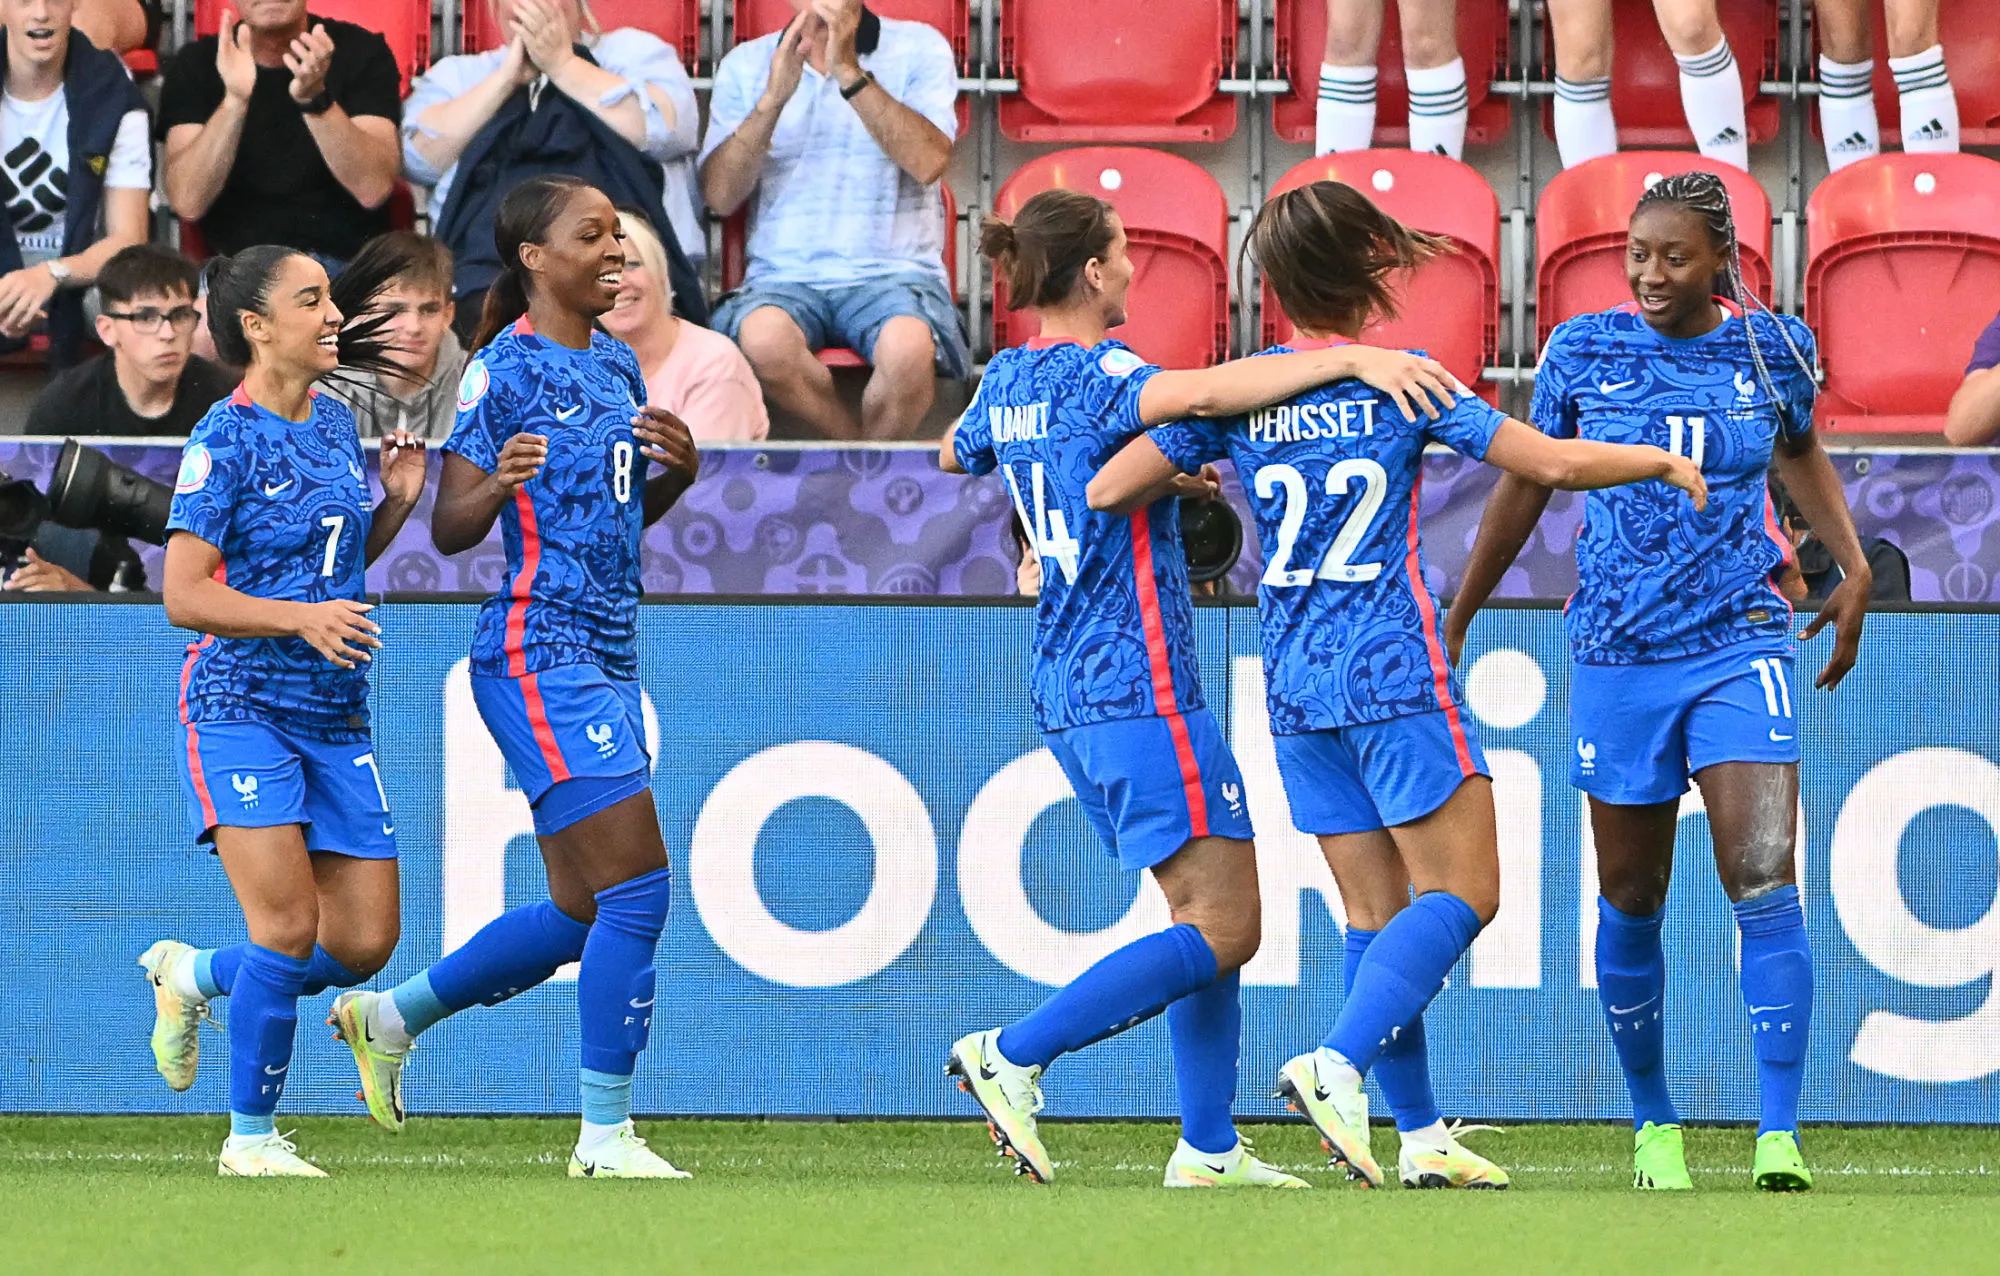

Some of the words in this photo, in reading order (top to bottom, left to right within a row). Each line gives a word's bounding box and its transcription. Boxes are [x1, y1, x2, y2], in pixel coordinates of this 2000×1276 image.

[1250, 400, 1378, 442] PERISSET
[1665, 416, 1705, 471] 11
[614, 441, 633, 504] 8
[321, 516, 344, 577] 7
[1003, 462, 1081, 586] 14
[1254, 458, 1387, 587] 22
[1750, 658, 1792, 718] 11
[353, 753, 389, 812] 7
